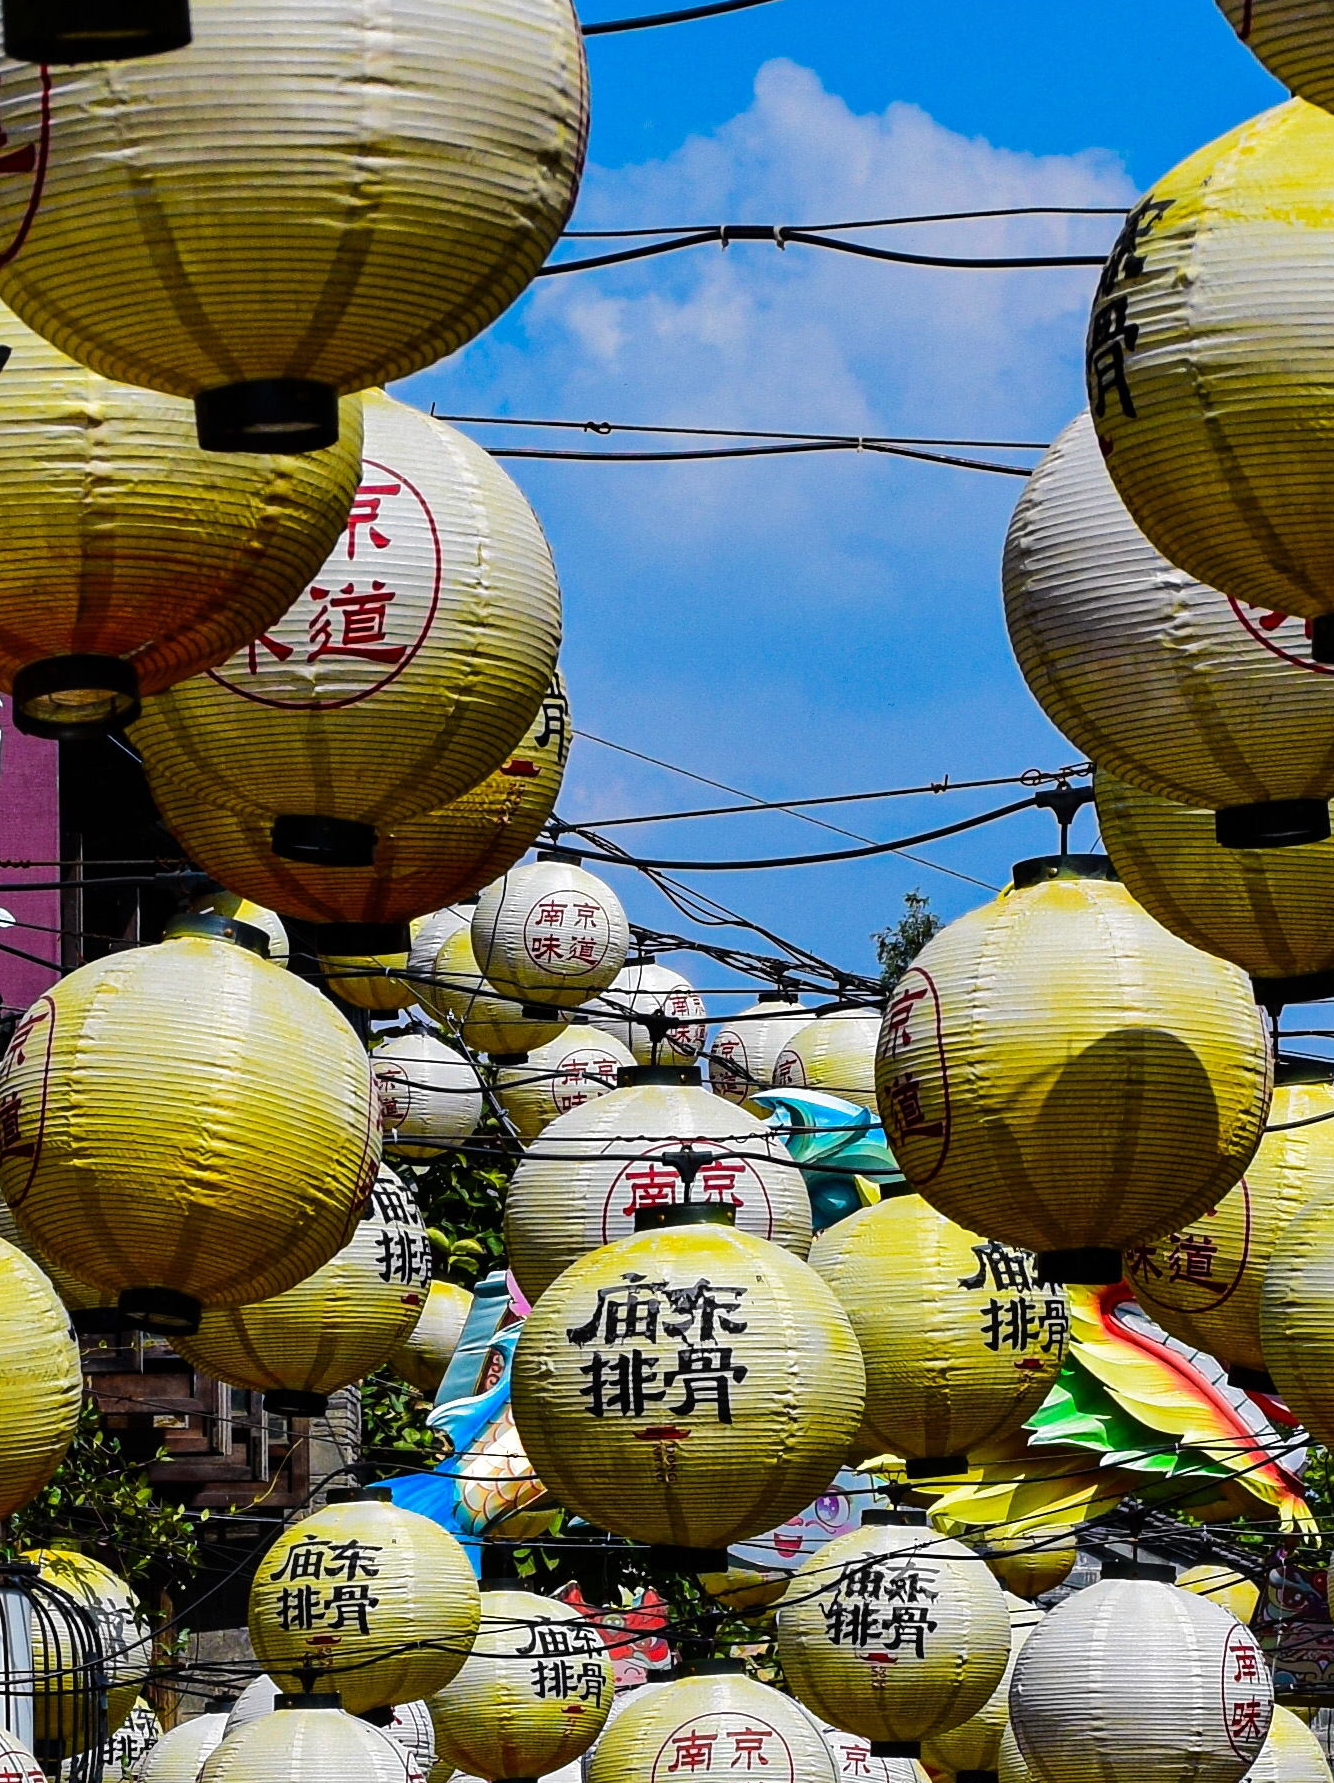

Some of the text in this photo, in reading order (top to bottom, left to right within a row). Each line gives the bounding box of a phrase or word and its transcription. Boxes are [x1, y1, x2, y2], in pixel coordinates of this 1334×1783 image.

[535, 901, 599, 927] 南京
[532, 937, 599, 966] 味道
[624, 1163, 745, 1215] 南京
[1128, 1235, 1229, 1293] 味道
[568, 1272, 748, 1347] 庙东
[980, 1298, 1068, 1363] 排骨
[580, 1347, 748, 1424] 排骨
[271, 1534, 383, 1581] 庙东
[277, 1585, 379, 1634] 排骨
[821, 1597, 938, 1659] 排骨
[516, 1615, 604, 1659] 庙东
[532, 1661, 608, 1709] 排骨
[668, 1728, 772, 1773] 南京
[839, 1743, 872, 1774] 京
